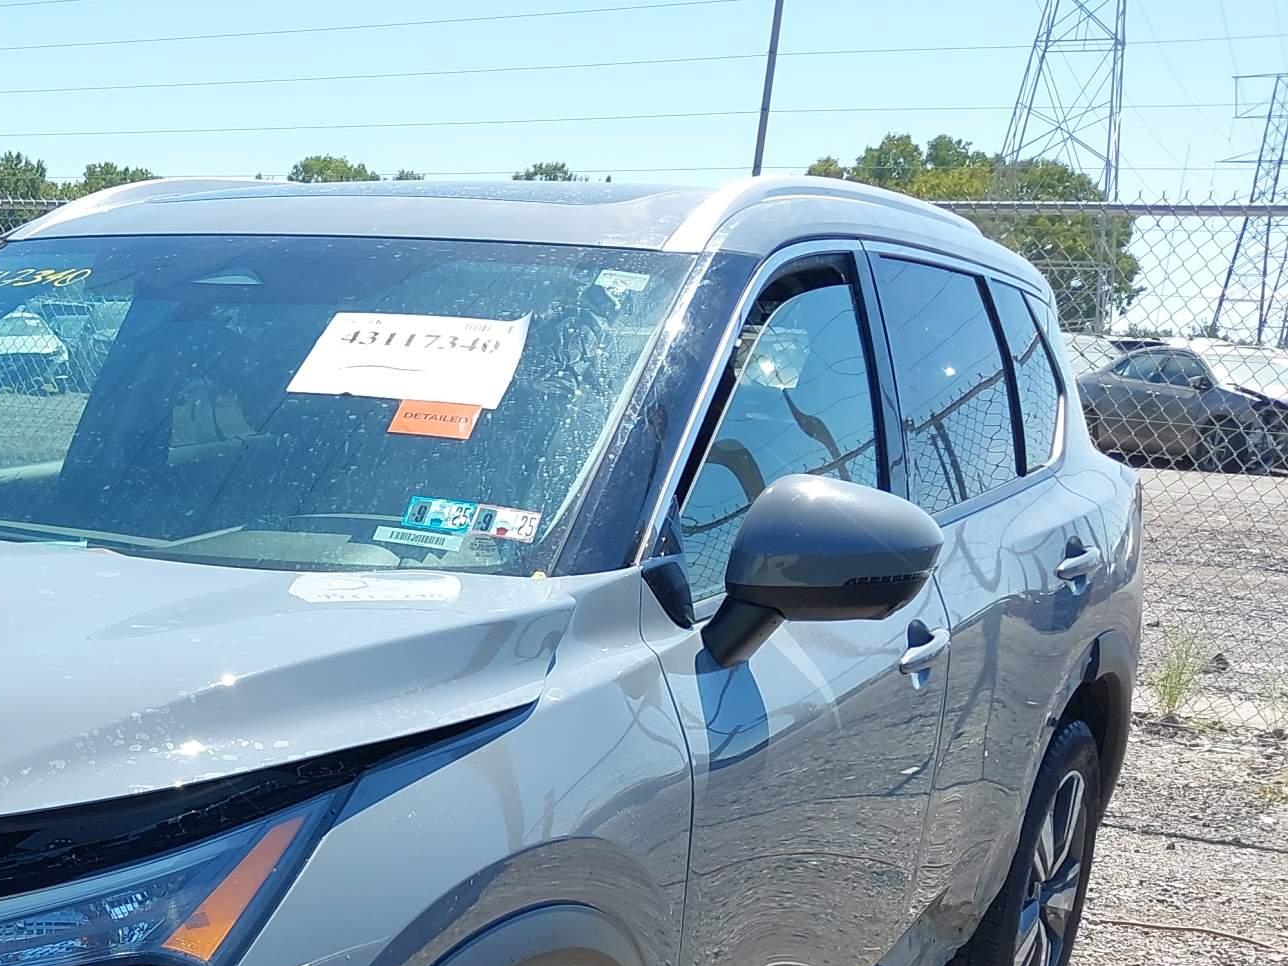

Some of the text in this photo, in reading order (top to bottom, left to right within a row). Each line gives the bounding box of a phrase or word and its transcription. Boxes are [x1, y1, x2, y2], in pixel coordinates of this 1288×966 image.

[340, 329, 502, 355] 43117340
[403, 411, 469, 425] DETAILED
[451, 506, 472, 527] 25
[517, 515, 538, 537] 25
